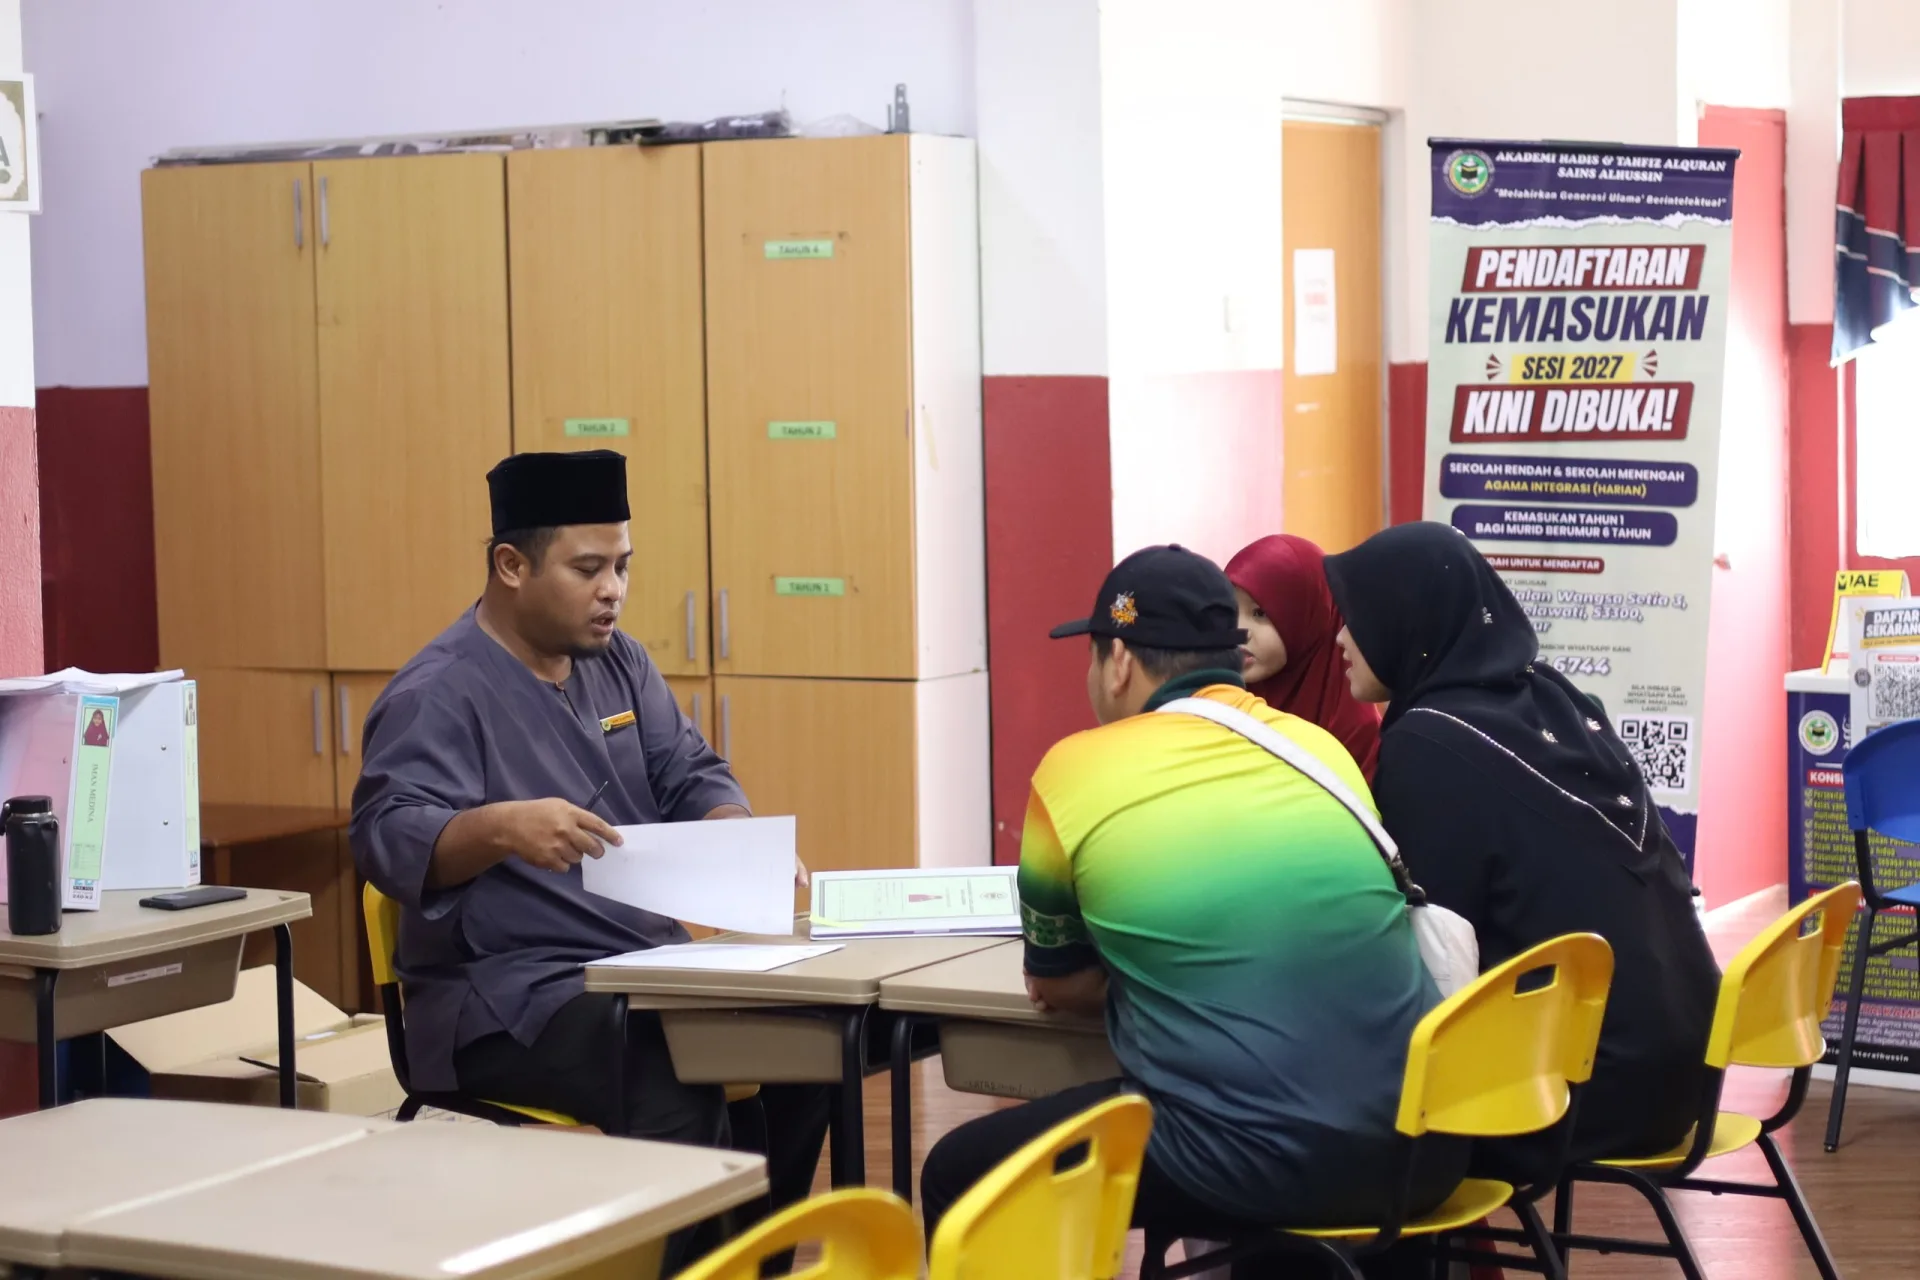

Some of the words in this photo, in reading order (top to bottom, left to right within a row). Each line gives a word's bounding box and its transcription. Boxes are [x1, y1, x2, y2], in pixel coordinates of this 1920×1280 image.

[1495, 151, 1556, 164] AKADEMI
[1558, 153, 1599, 166] HADIS
[1602, 155, 1614, 166] &
[1616, 156, 1662, 169] TAHFIZ
[1663, 159, 1726, 172] ALQURAN
[1557, 167, 1597, 179] SAINS
[1598, 169, 1663, 182] ALHUSSIN
[1560, 190, 1606, 201] Generasi
[1475, 247, 1690, 288] PENDAFTARAN
[1445, 295, 1710, 344] KEMASUKAN
[1521, 355, 1565, 380] SESI
[1569, 355, 1623, 379] 2027
[1463, 390, 1535, 434] KINI
[1540, 388, 1680, 433] DIBUKA!
[1449, 462, 1502, 475] SEKOLAH
[1504, 464, 1551, 477] RENDAH
[1553, 466, 1562, 477] &
[1564, 467, 1616, 479] SEKOLAH
[1618, 469, 1685, 482] MENENGAH
[1484, 480, 1528, 492] AGAMA
[1530, 482, 1591, 494] INTEGRASI
[1593, 483, 1647, 499] (HARIAN)
[1504, 511, 1575, 524] KEMASUKAN
[1577, 513, 1617, 525] TAHUN
[1619, 514, 1624, 525] 1
[1475, 523, 1505, 534] BAGI
[1506, 524, 1544, 536] MURID
[1545, 525, 1600, 538] BERUMUR
[1602, 527, 1610, 538] 6
[1611, 527, 1652, 539] TAHUN
[1510, 557, 1542, 568] UNTUK
[1543, 558, 1599, 570] MENDAFTAR
[788, 582, 822, 592] TAHUN
[1557, 589, 1624, 606] Wangsa
[1627, 592, 1669, 606] Setia
[1873, 609, 1920, 624] DAFTAR
[1552, 655, 1612, 675] 6744
